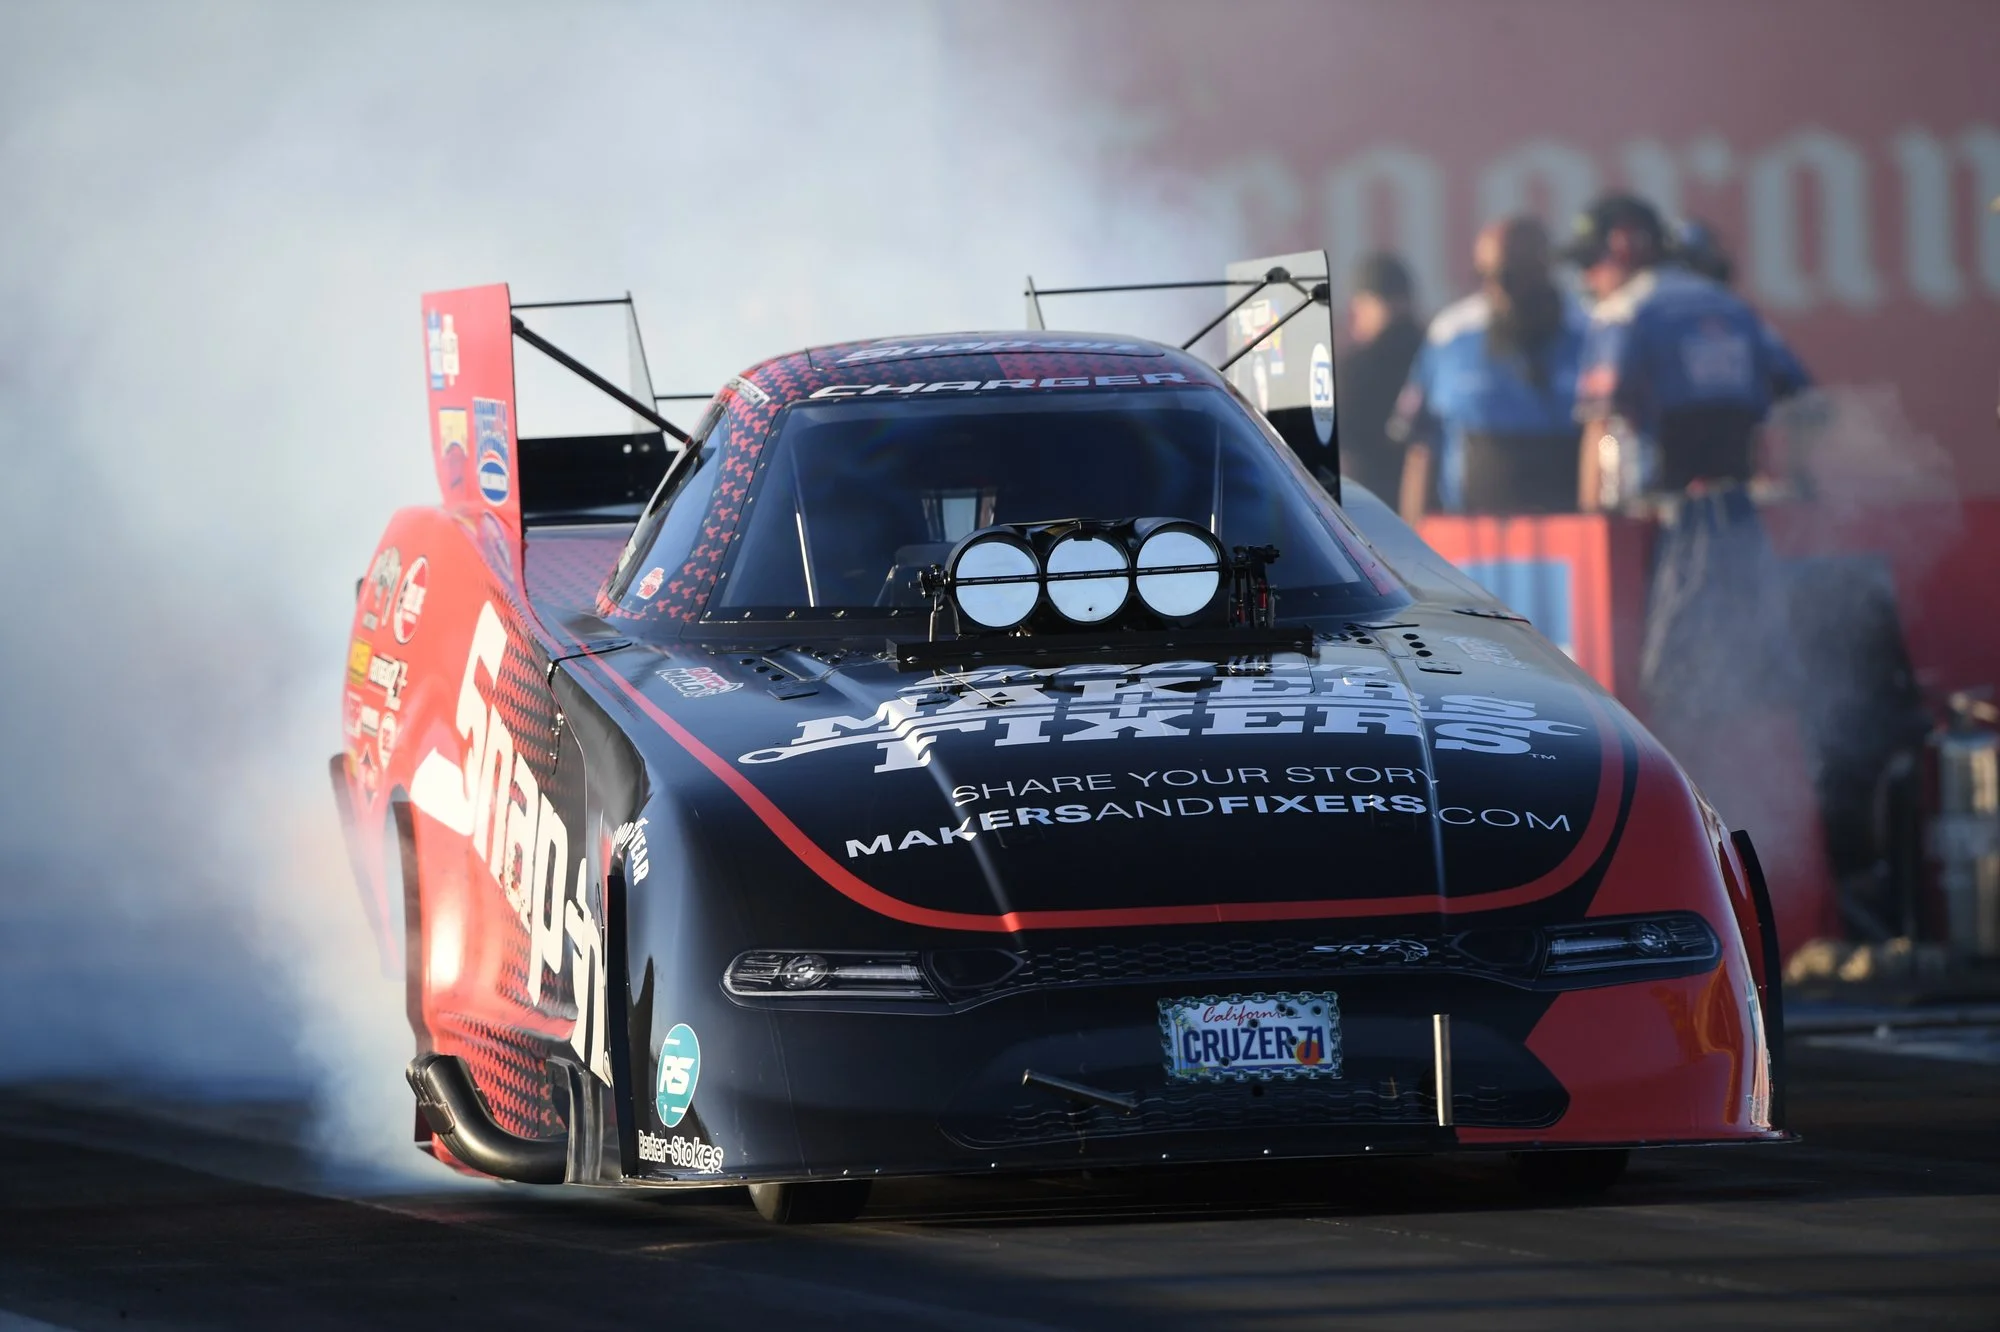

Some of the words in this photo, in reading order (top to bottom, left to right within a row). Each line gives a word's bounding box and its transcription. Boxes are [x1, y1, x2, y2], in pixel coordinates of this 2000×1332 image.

[809, 371, 1192, 399] CHARGER
[791, 675, 1537, 746] MAKERS
[874, 706, 1532, 773] FIXERS
[951, 773, 1116, 807] SHARE
[1129, 767, 1270, 789] YOUR
[1286, 767, 1439, 786] STORY
[846, 795, 1571, 858] MAKERSANDFIXERS.COM
[1306, 944, 1400, 955] SRT
[1203, 1004, 1302, 1026] Californi
[1183, 1027, 1296, 1064] CRUZER
[1298, 1026, 1325, 1059] 71
[659, 1055, 695, 1095] RS
[638, 1130, 724, 1169] Reuter-Stokes
